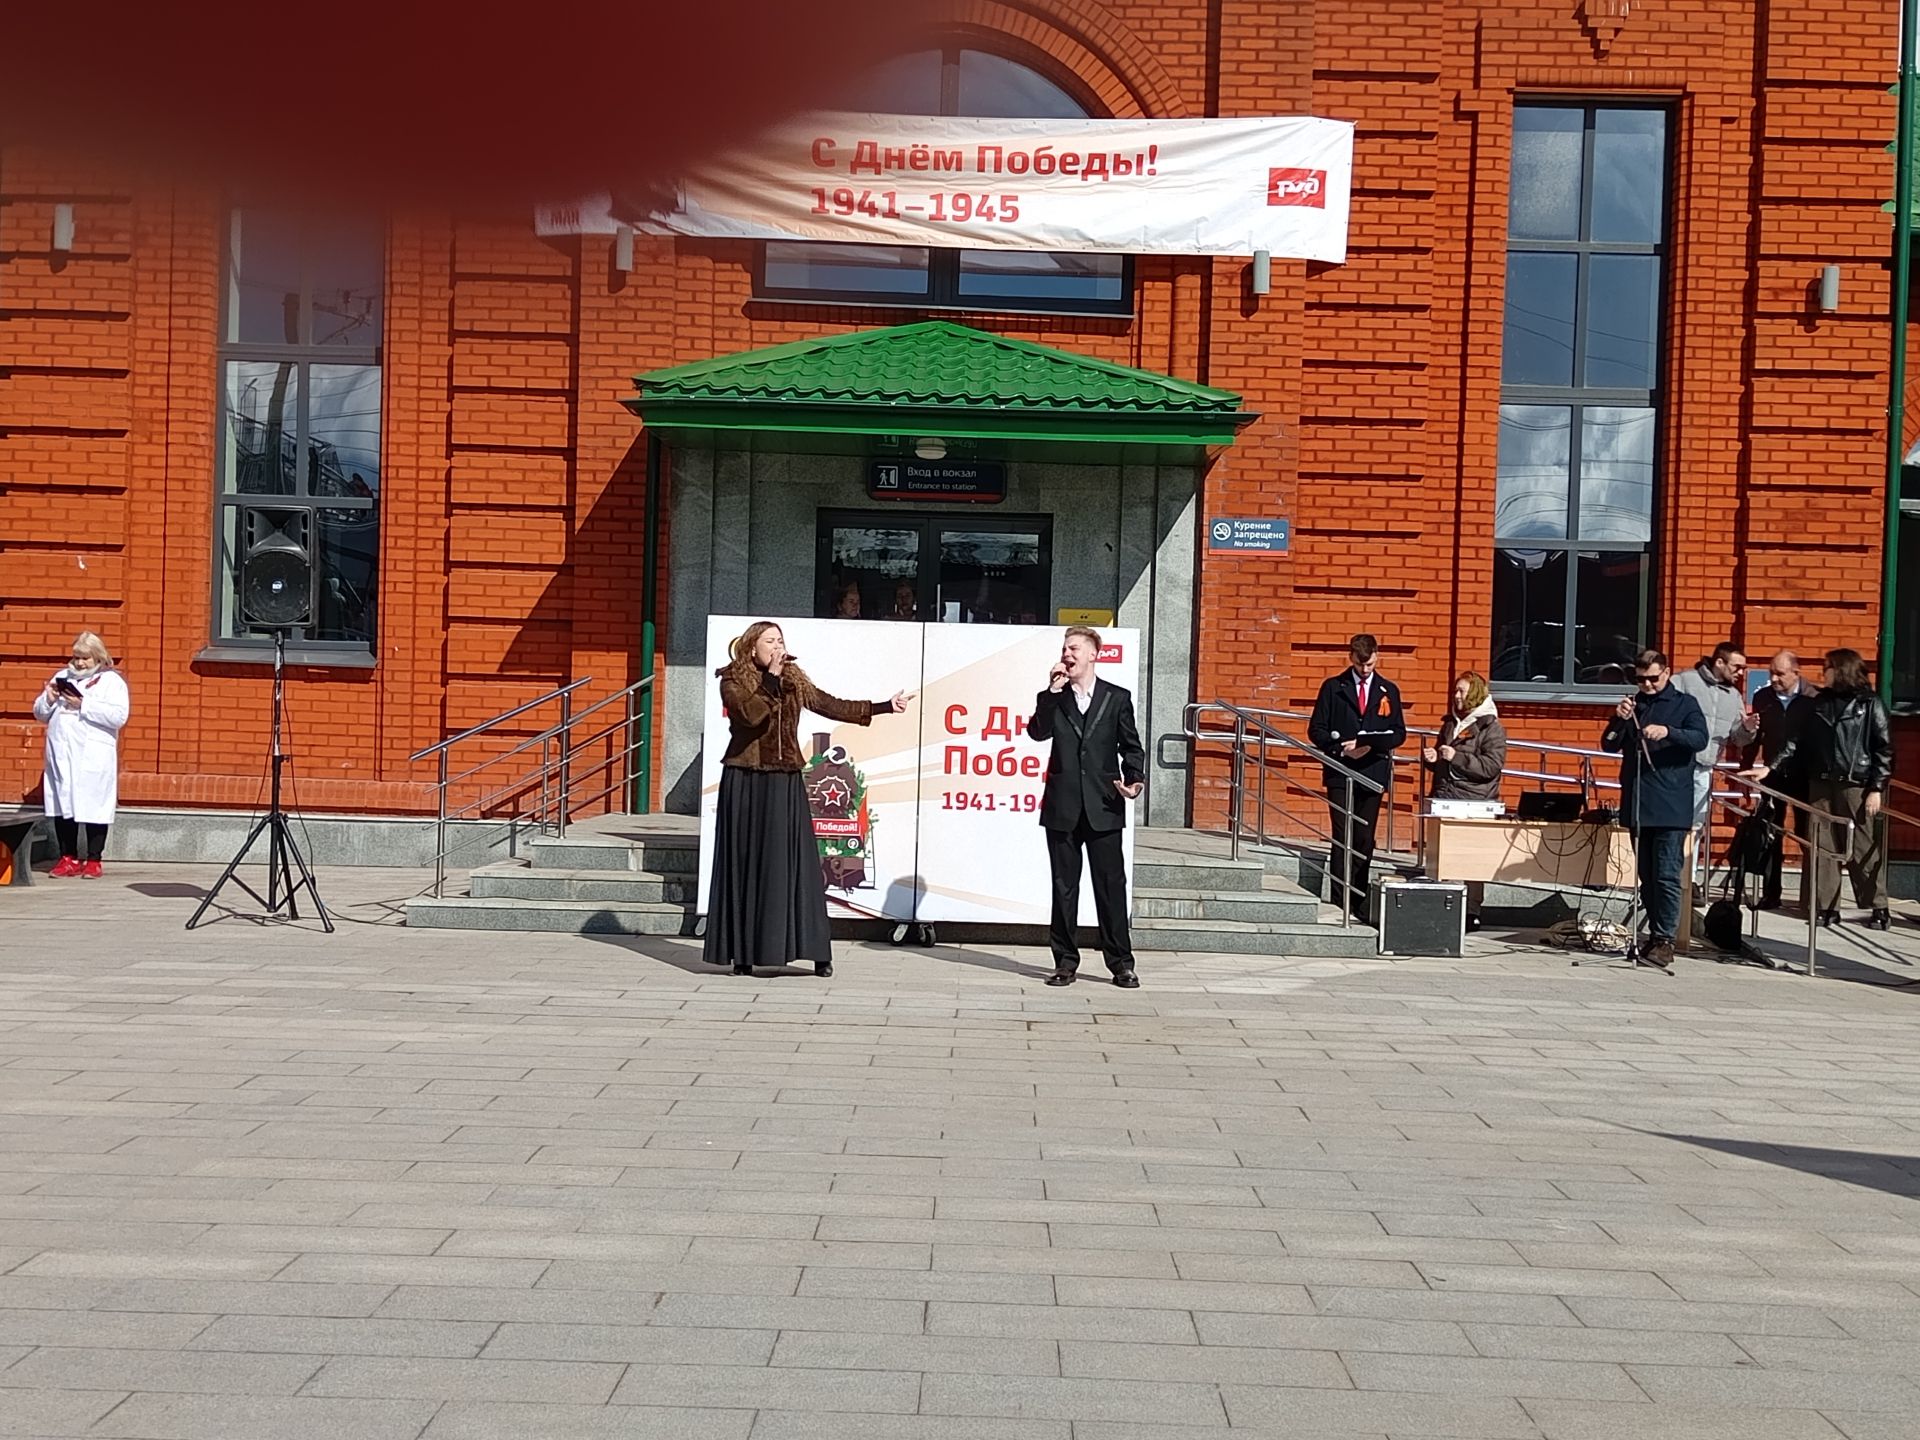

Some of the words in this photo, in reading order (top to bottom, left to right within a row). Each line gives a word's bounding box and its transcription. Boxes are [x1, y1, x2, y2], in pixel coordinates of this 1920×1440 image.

[811, 138, 836, 168] С
[850, 141, 963, 175] Днём
[976, 144, 1158, 182] Победы!
[907, 466, 932, 478] Вход
[942, 470, 977, 478] вокзал
[908, 481, 940, 490] Entrance
[951, 483, 977, 491] station
[1234, 521, 1272, 531] Курение
[1233, 531, 1285, 540] запрещено
[1244, 541, 1271, 549] smoking
[944, 704, 968, 735] С
[942, 791, 1042, 813] 1941-19
[816, 822, 858, 832] Победой!
